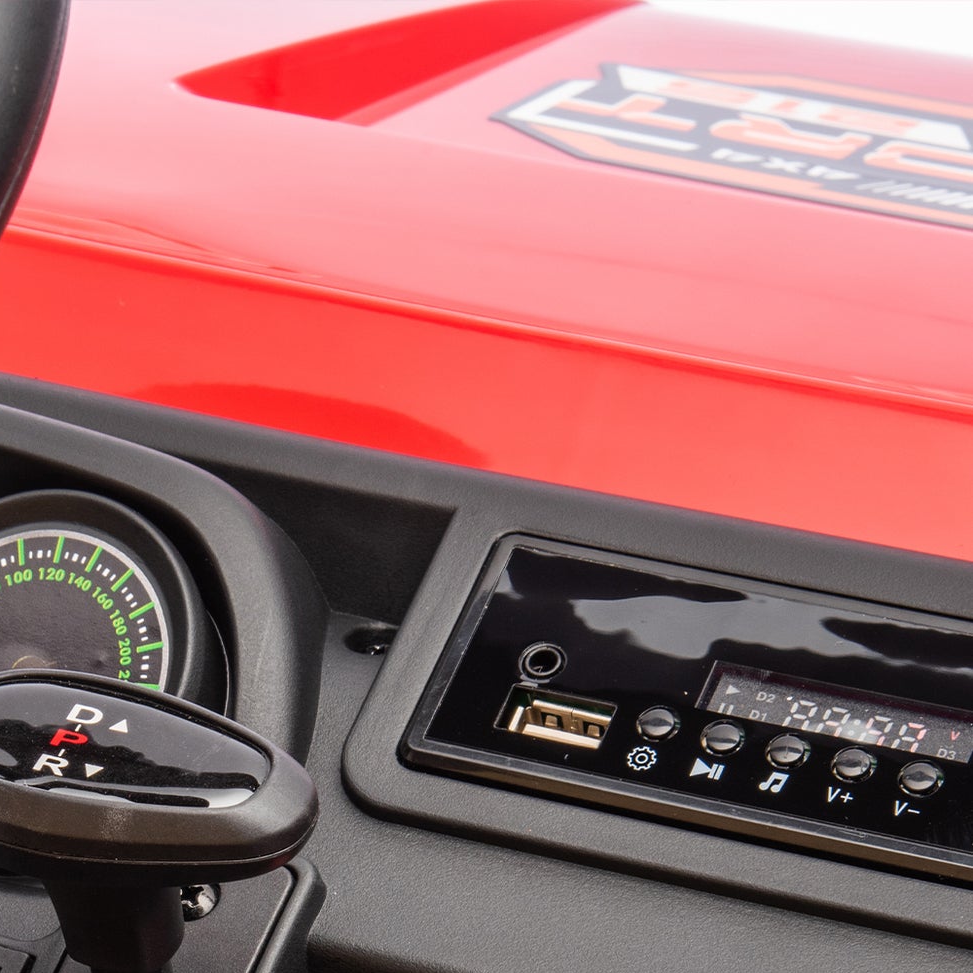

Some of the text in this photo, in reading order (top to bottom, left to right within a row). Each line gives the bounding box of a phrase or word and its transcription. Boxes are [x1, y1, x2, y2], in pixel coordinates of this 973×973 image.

[4, 568, 34, 587] 100
[38, 567, 67, 583] 120
[67, 572, 93, 592] 140
[91, 586, 115, 611] 160
[109, 609, 128, 636] 180
[118, 637, 133, 666] 200
[755, 691, 776, 704] D2
[66, 703, 104, 725] D
[749, 708, 768, 721] D1
[49, 728, 89, 747] P
[937, 748, 957, 760] D3
[32, 753, 70, 777] R
[826, 786, 854, 804] V+
[893, 800, 921, 817] V-
